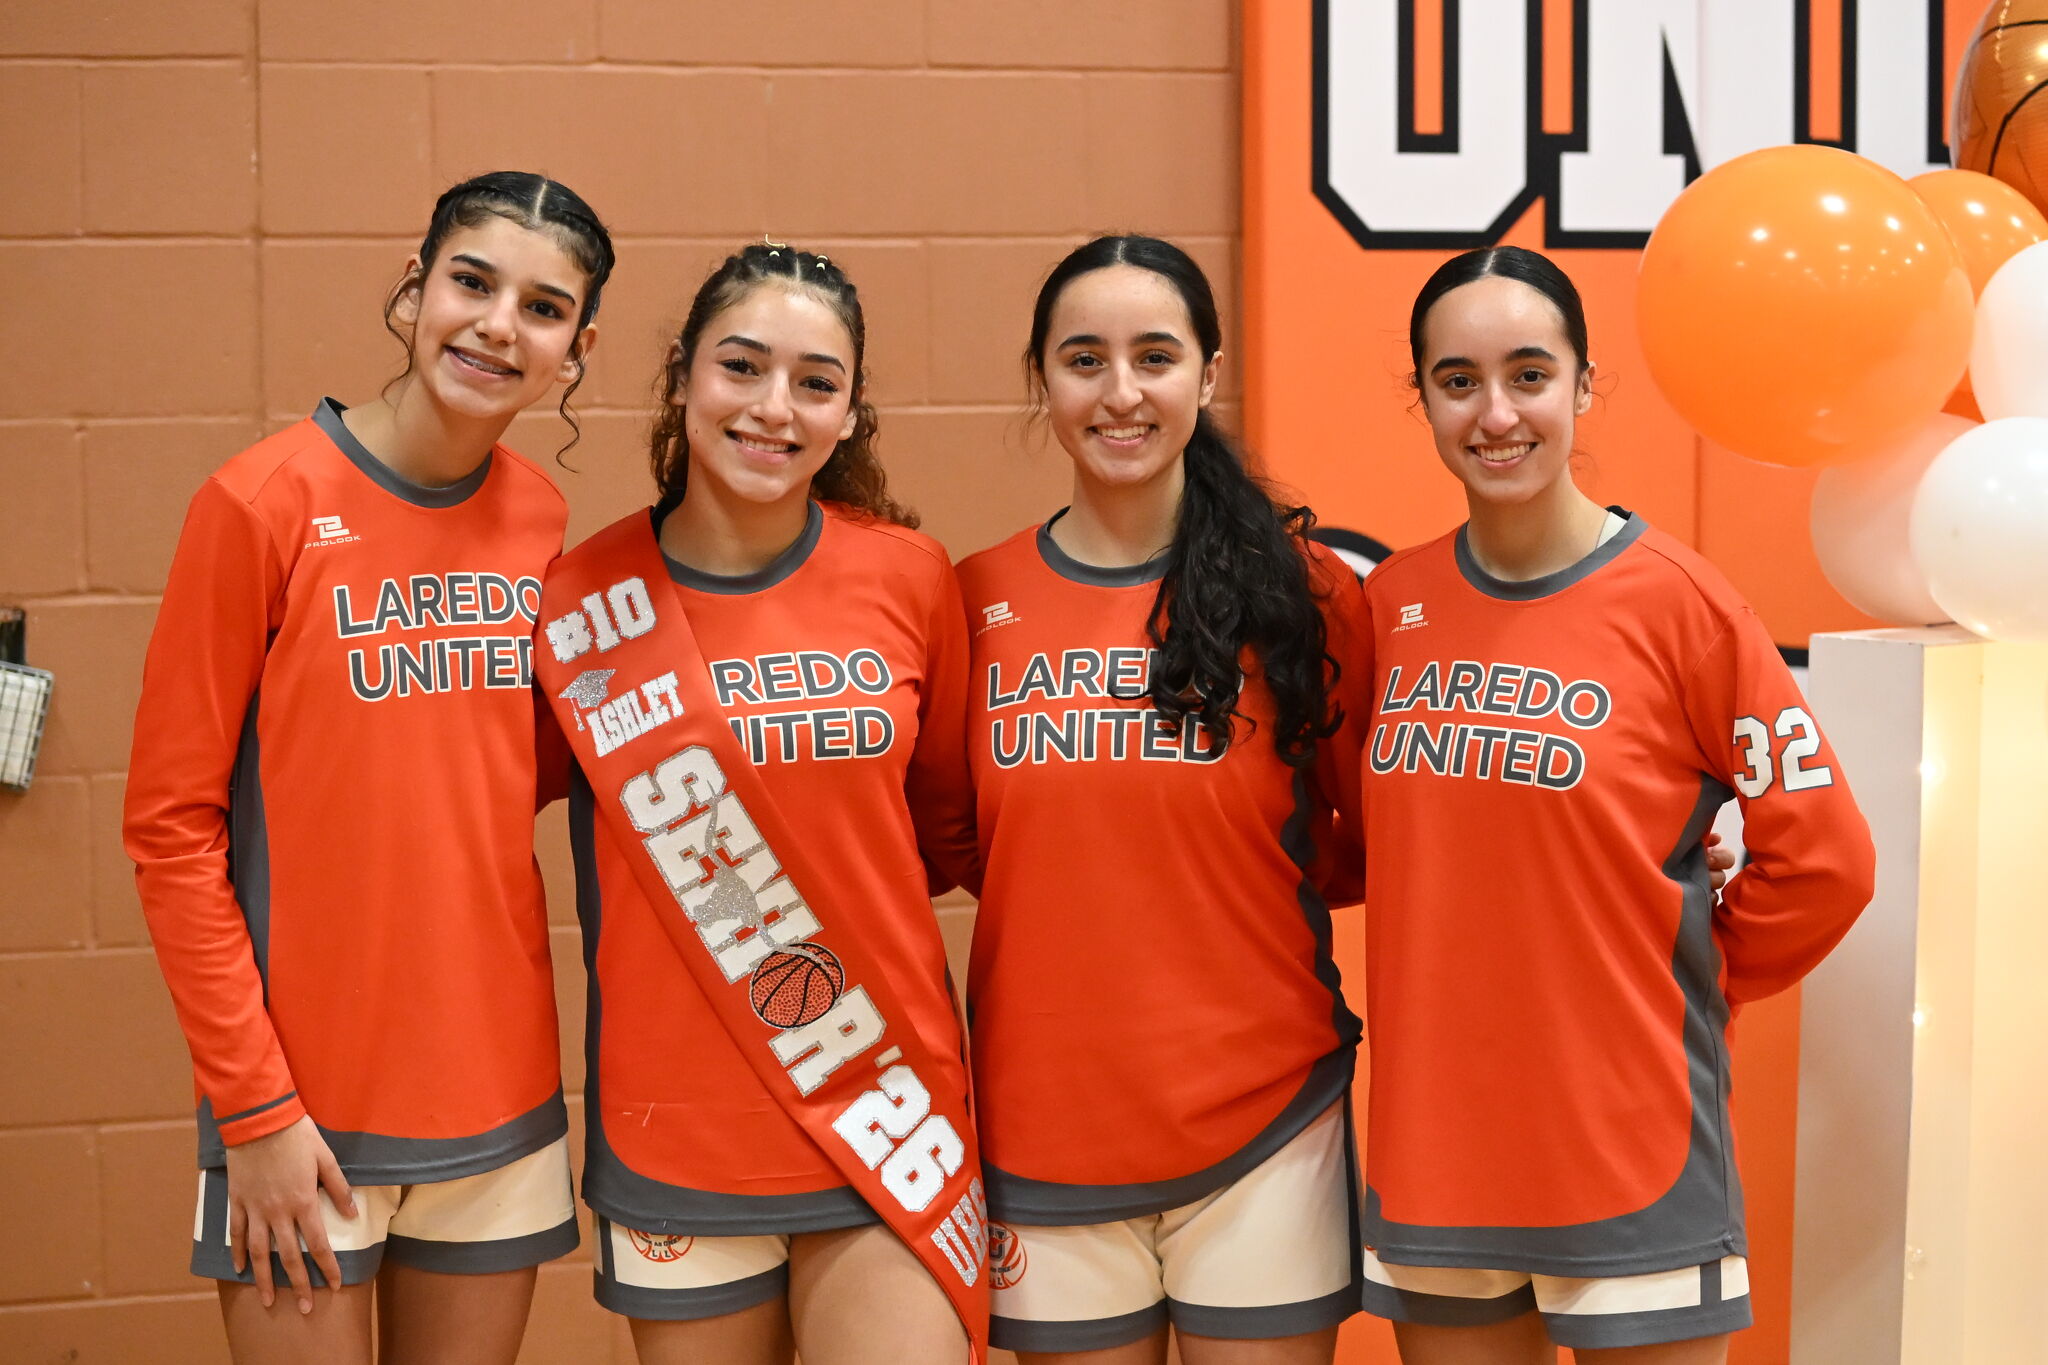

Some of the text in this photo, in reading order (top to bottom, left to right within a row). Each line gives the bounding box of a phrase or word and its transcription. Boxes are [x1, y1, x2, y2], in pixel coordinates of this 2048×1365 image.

[304, 535, 361, 549] PROLOOK
[545, 576, 657, 664] #10
[709, 648, 893, 706] REDO
[1379, 660, 1612, 729] LAREDO
[991, 708, 1229, 769] UNITED
[1370, 722, 1586, 791] UNITED
[1733, 706, 1833, 799] 32
